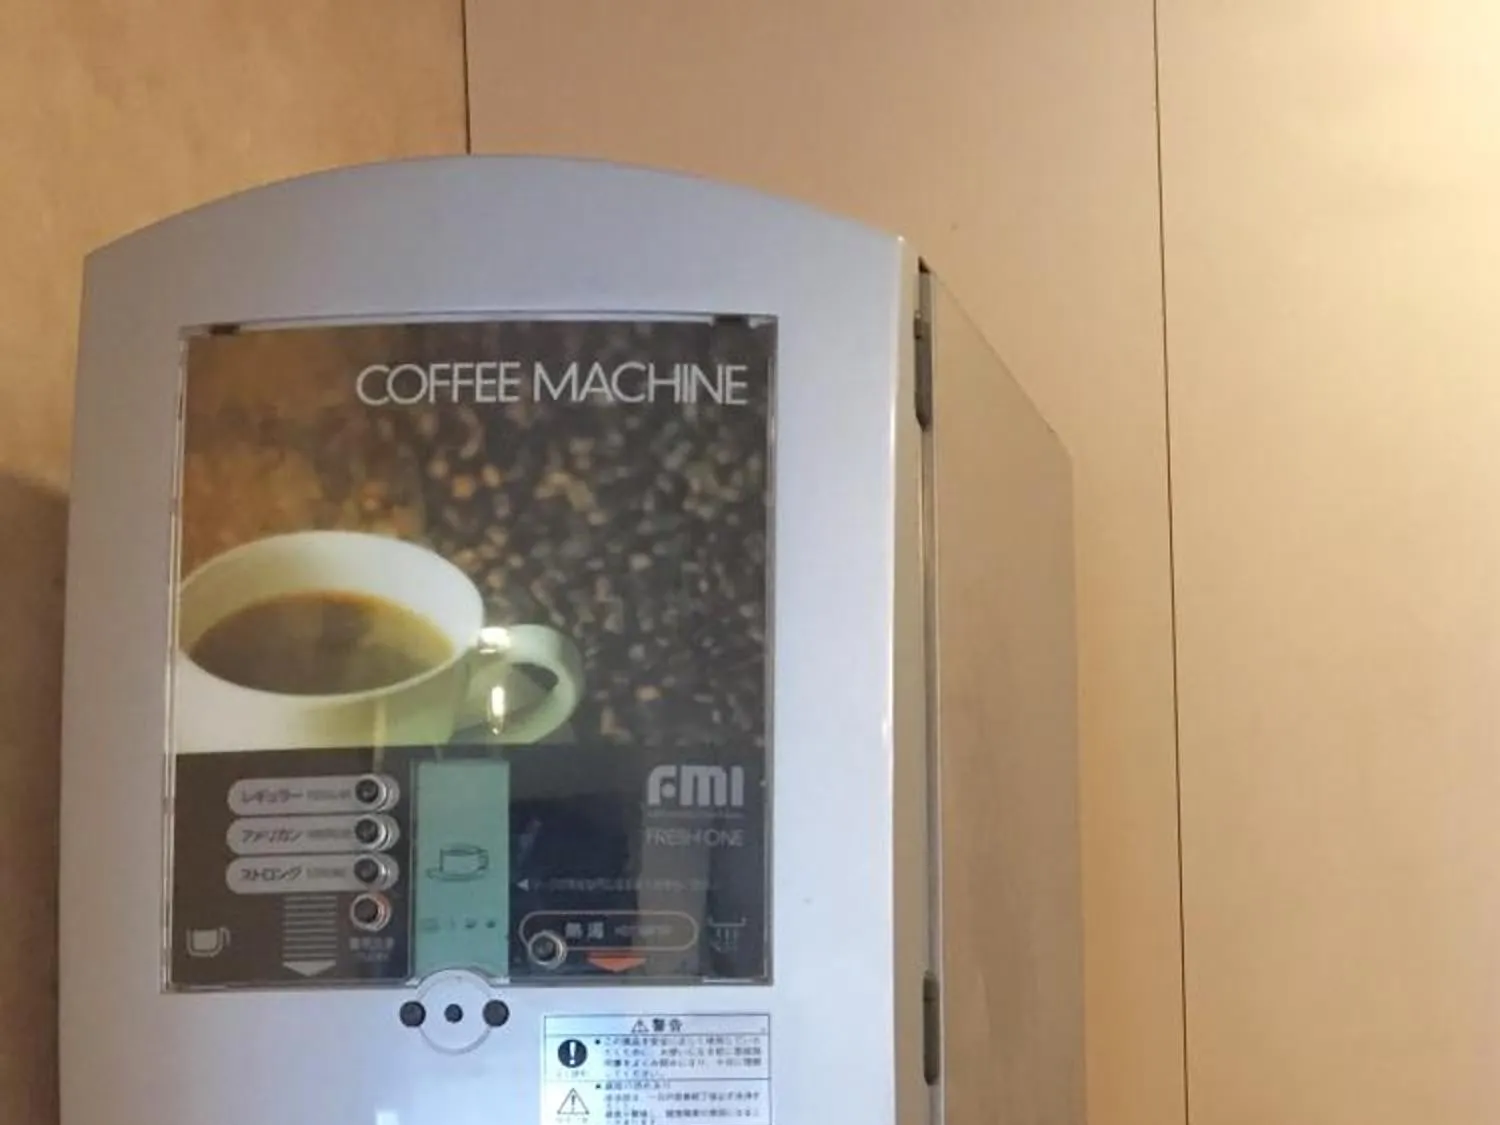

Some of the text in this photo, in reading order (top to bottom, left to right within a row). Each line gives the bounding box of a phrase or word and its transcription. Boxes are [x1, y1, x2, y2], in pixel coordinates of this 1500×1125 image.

[355, 360, 749, 406] COFFEE MACHINE
[240, 866, 303, 882] ストロング
